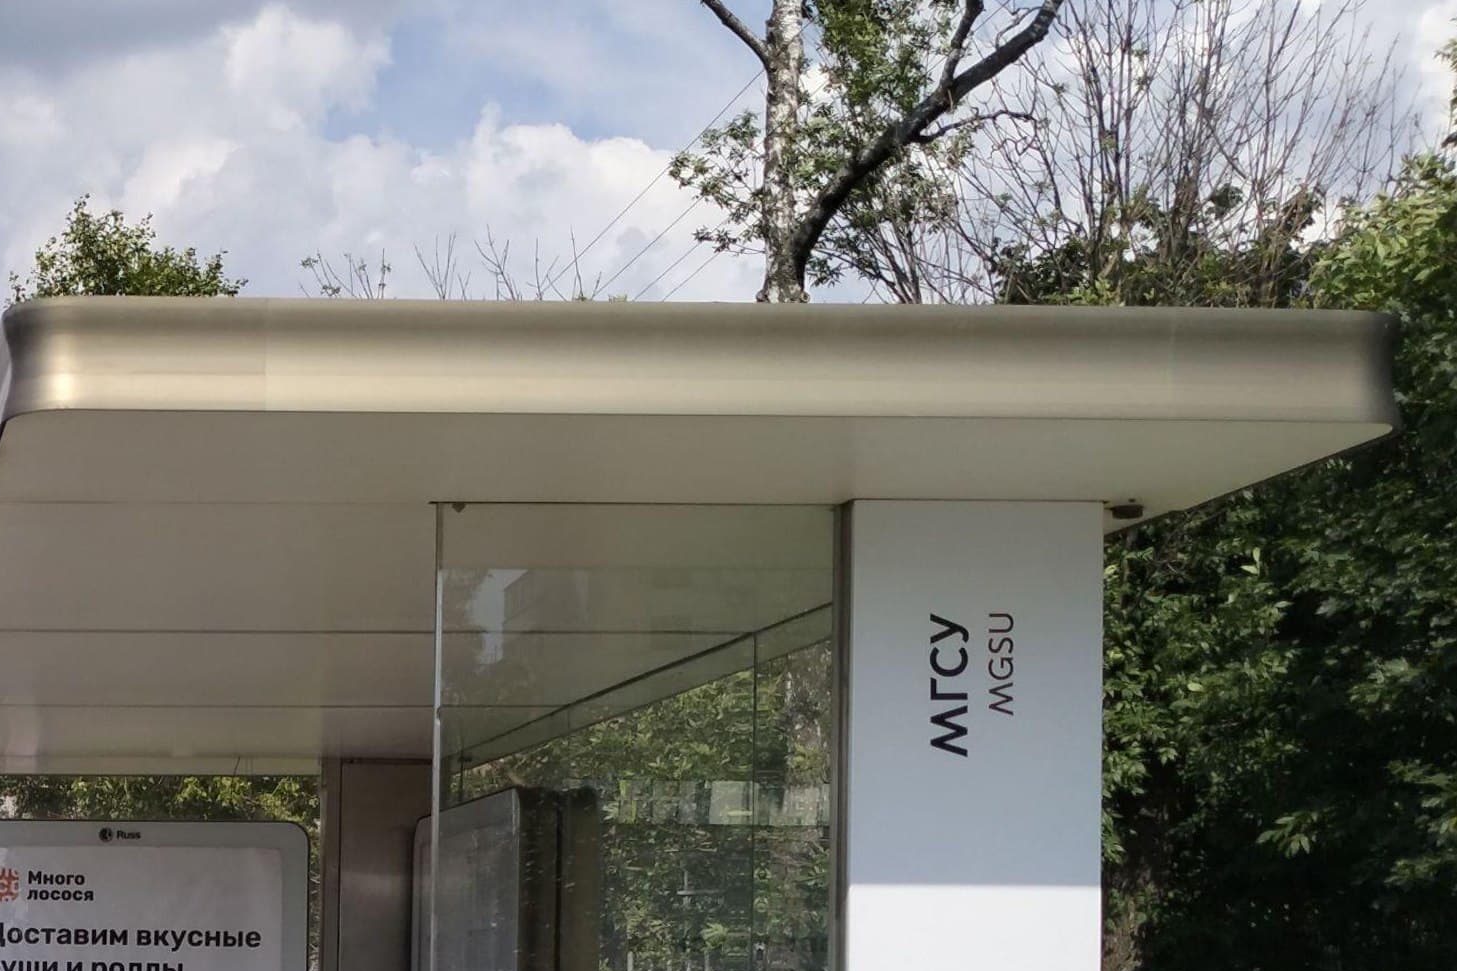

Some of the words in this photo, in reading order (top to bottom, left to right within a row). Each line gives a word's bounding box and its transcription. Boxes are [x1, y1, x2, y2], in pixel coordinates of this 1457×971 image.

[988, 612, 1014, 716] MGSU
[929, 613, 969, 757] МГСУ
[116, 829, 142, 840] Russ
[28, 870, 85, 885] Много
[27, 889, 94, 901] лосося
[136, 928, 262, 952] вкусные
